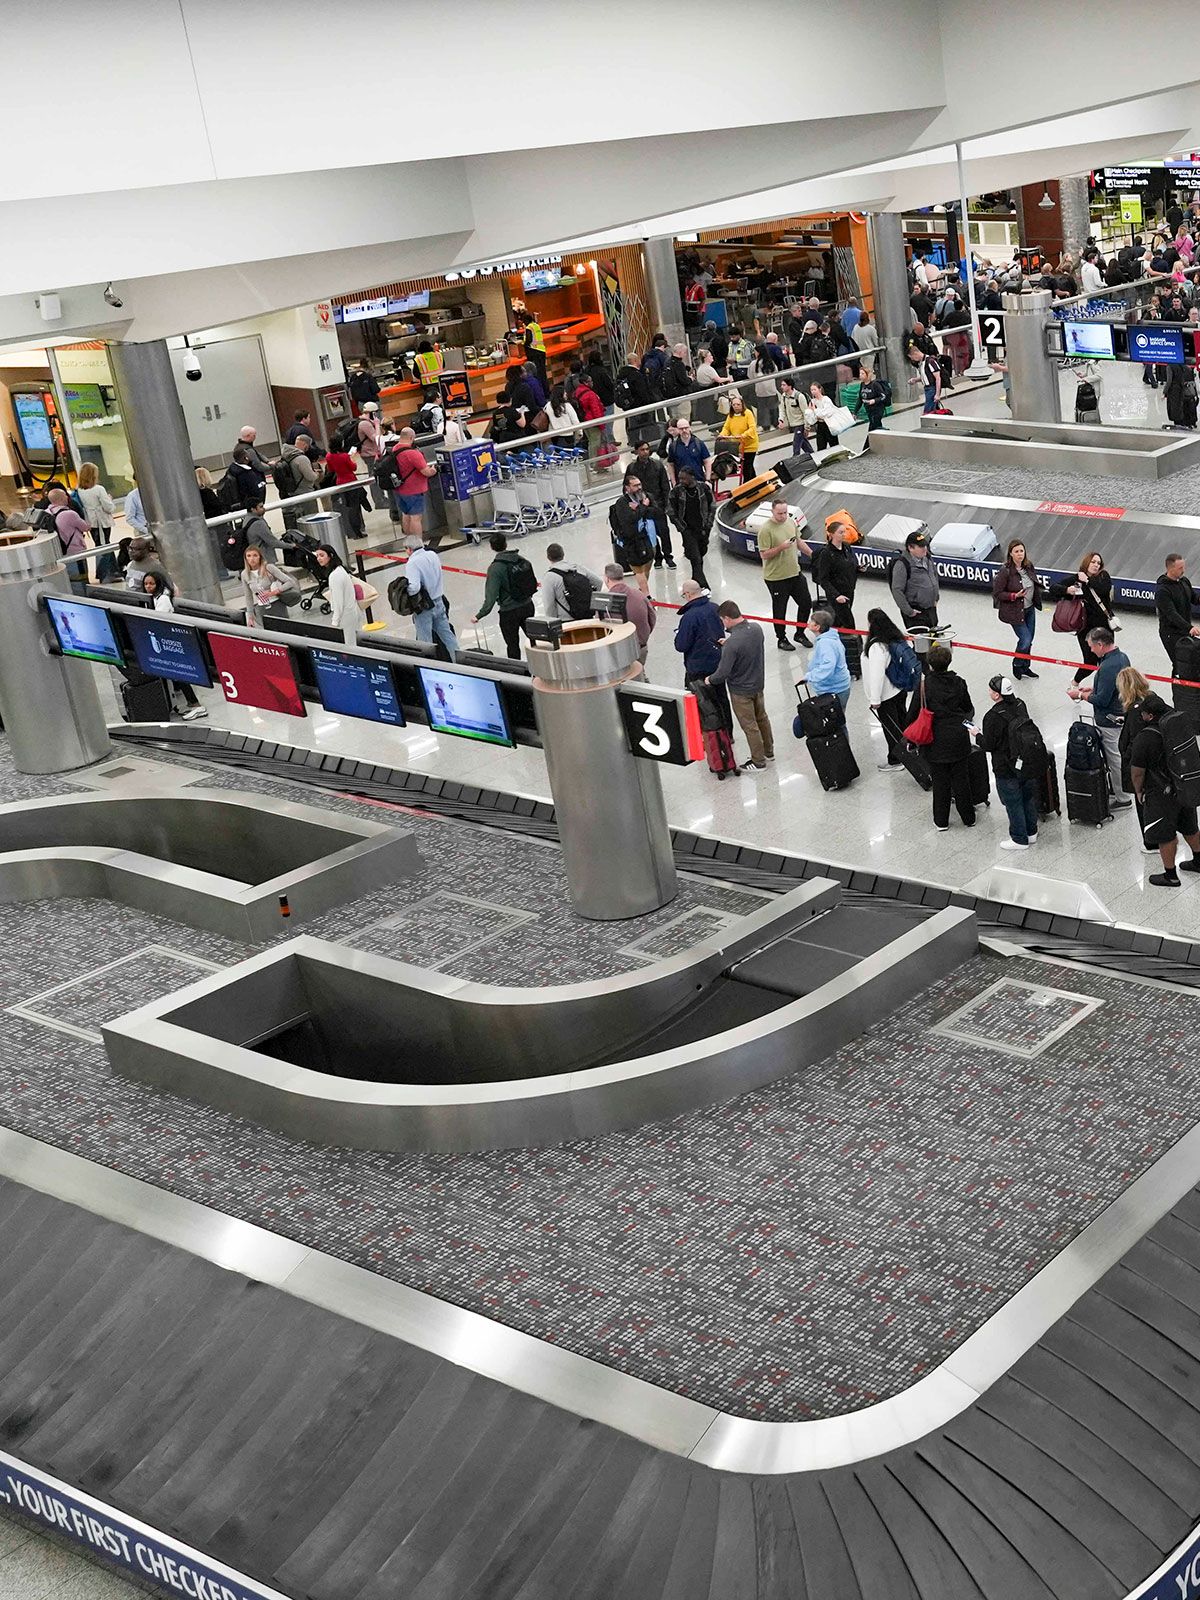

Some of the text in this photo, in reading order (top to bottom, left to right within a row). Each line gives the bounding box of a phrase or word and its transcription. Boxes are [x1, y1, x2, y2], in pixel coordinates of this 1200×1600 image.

[1169, 168, 1191, 176] Ticketing
[984, 318, 1003, 344] 2
[854, 552, 885, 570] YOUR
[934, 562, 965, 579] CKED
[967, 566, 990, 582] BAG
[258, 646, 281, 657] DELTA
[221, 671, 239, 699] 3
[631, 701, 671, 755] 3
[7, 1475, 73, 1532] YOUR
[70, 1507, 131, 1563] FIRST
